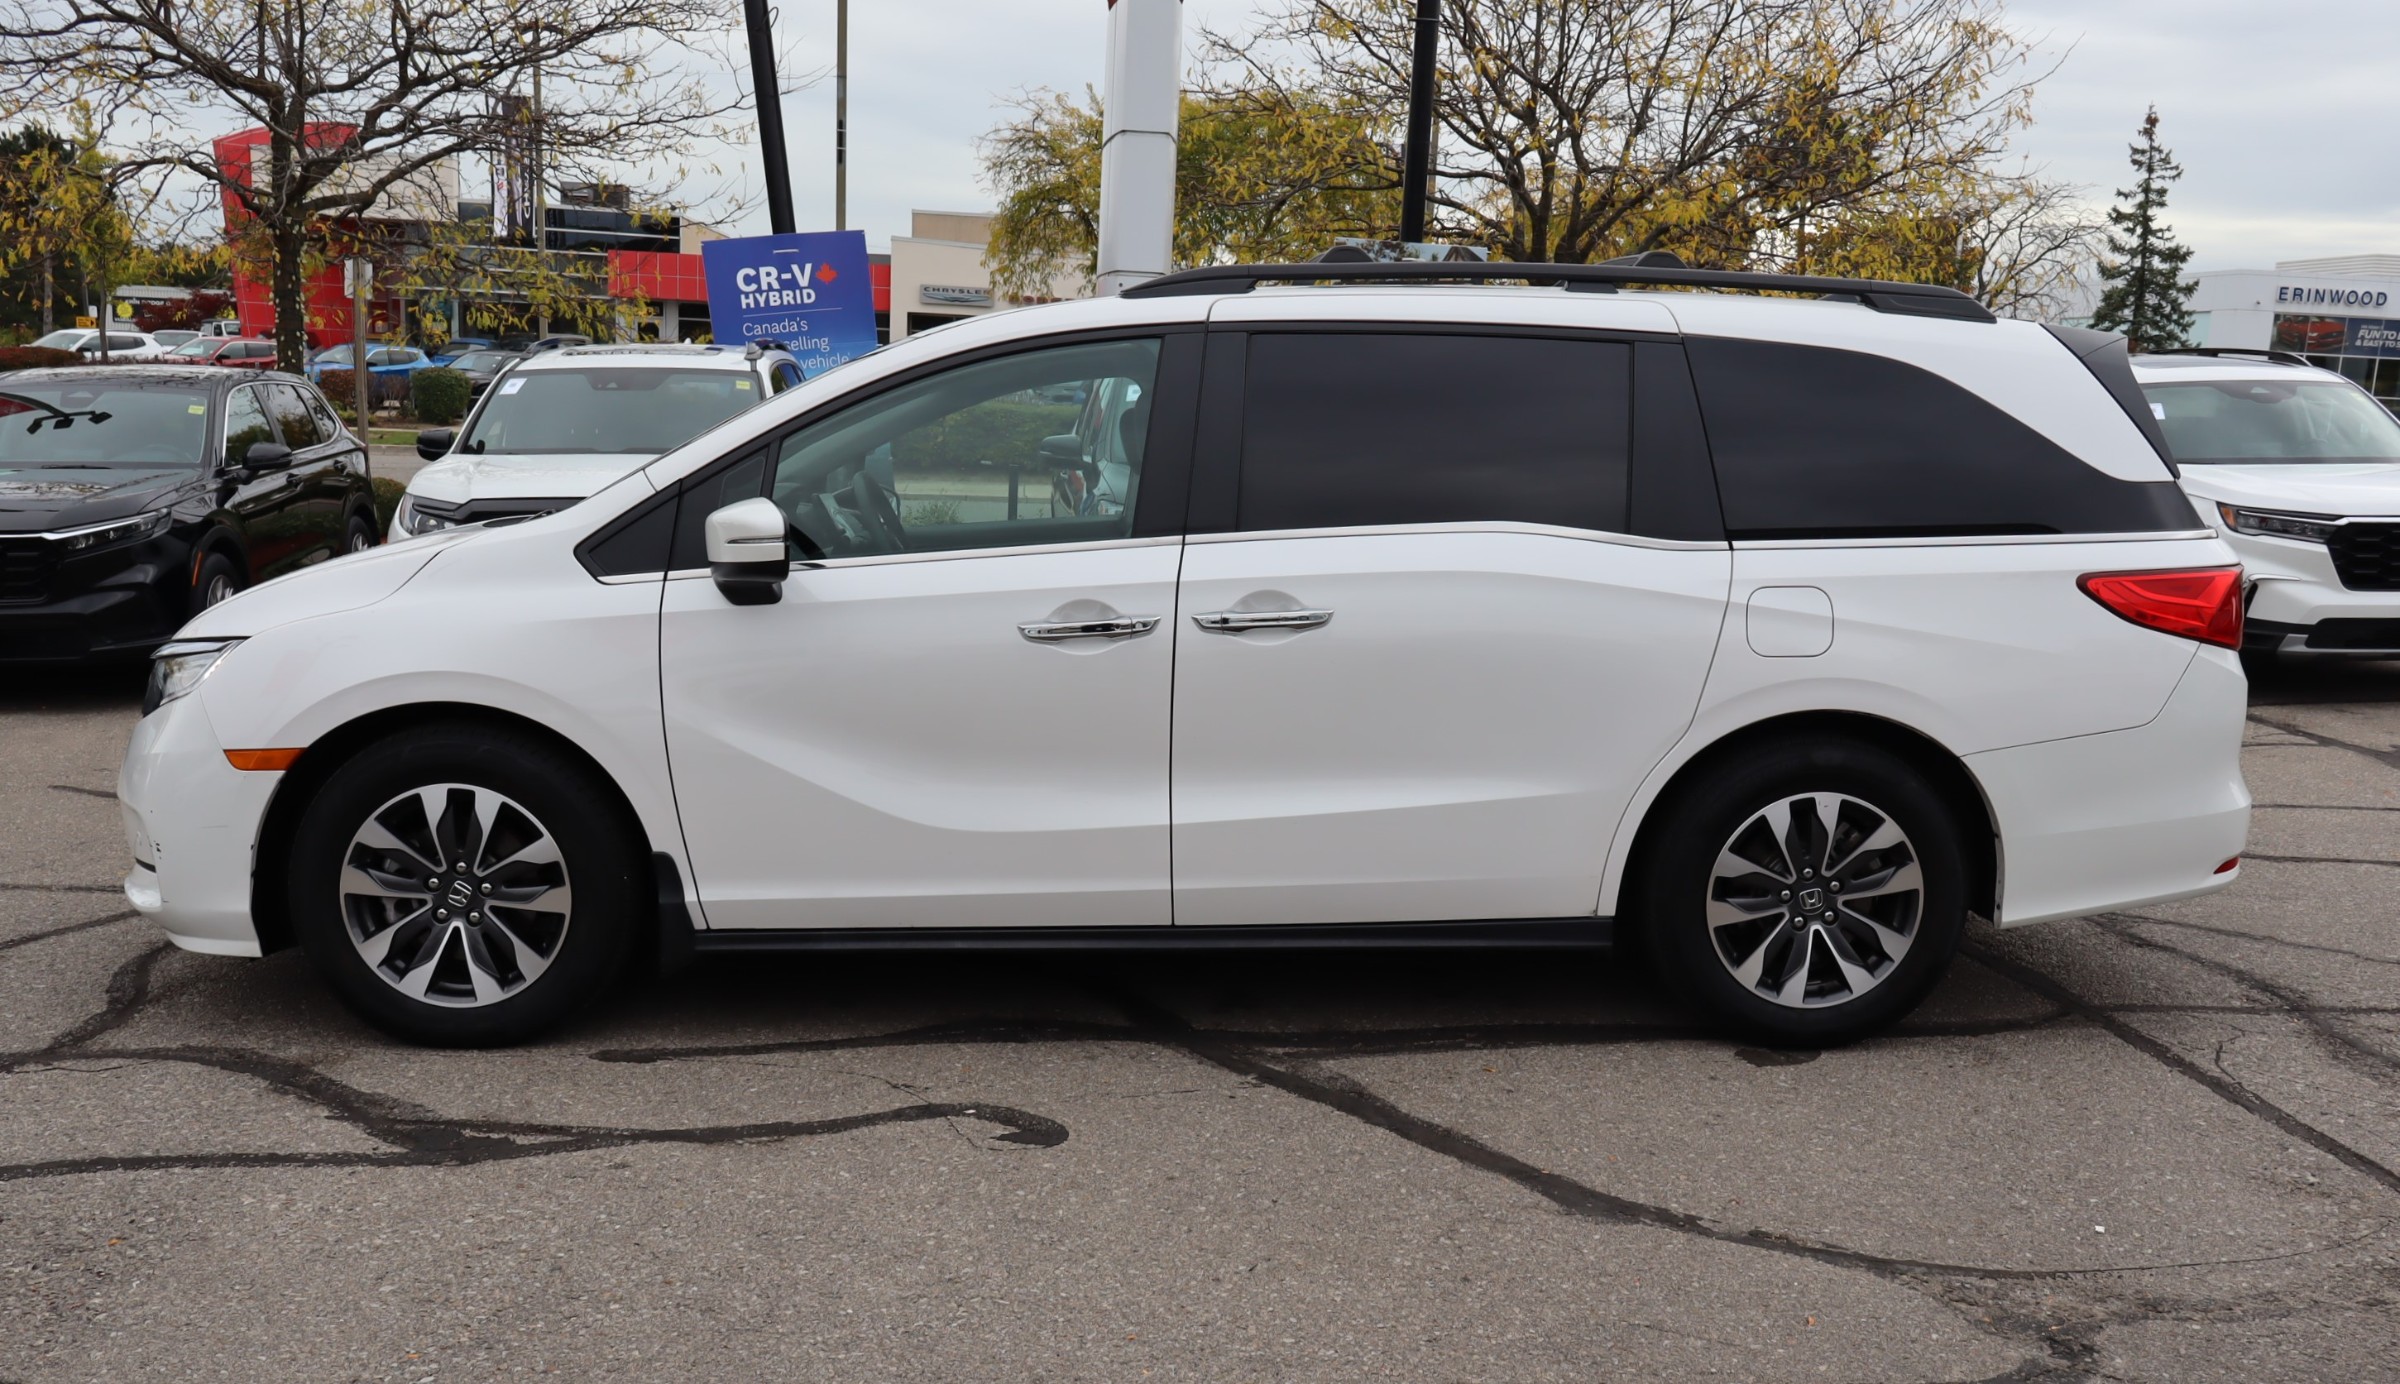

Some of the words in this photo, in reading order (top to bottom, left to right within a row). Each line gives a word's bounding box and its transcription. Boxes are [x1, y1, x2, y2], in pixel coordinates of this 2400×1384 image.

[736, 263, 813, 292] CR-V
[740, 288, 816, 309] HYBRID
[2278, 286, 2388, 306] ERINWOOD
[743, 317, 809, 337] Canada's
[2358, 329, 2381, 339] FUN
[2382, 330, 2397, 340] TO
